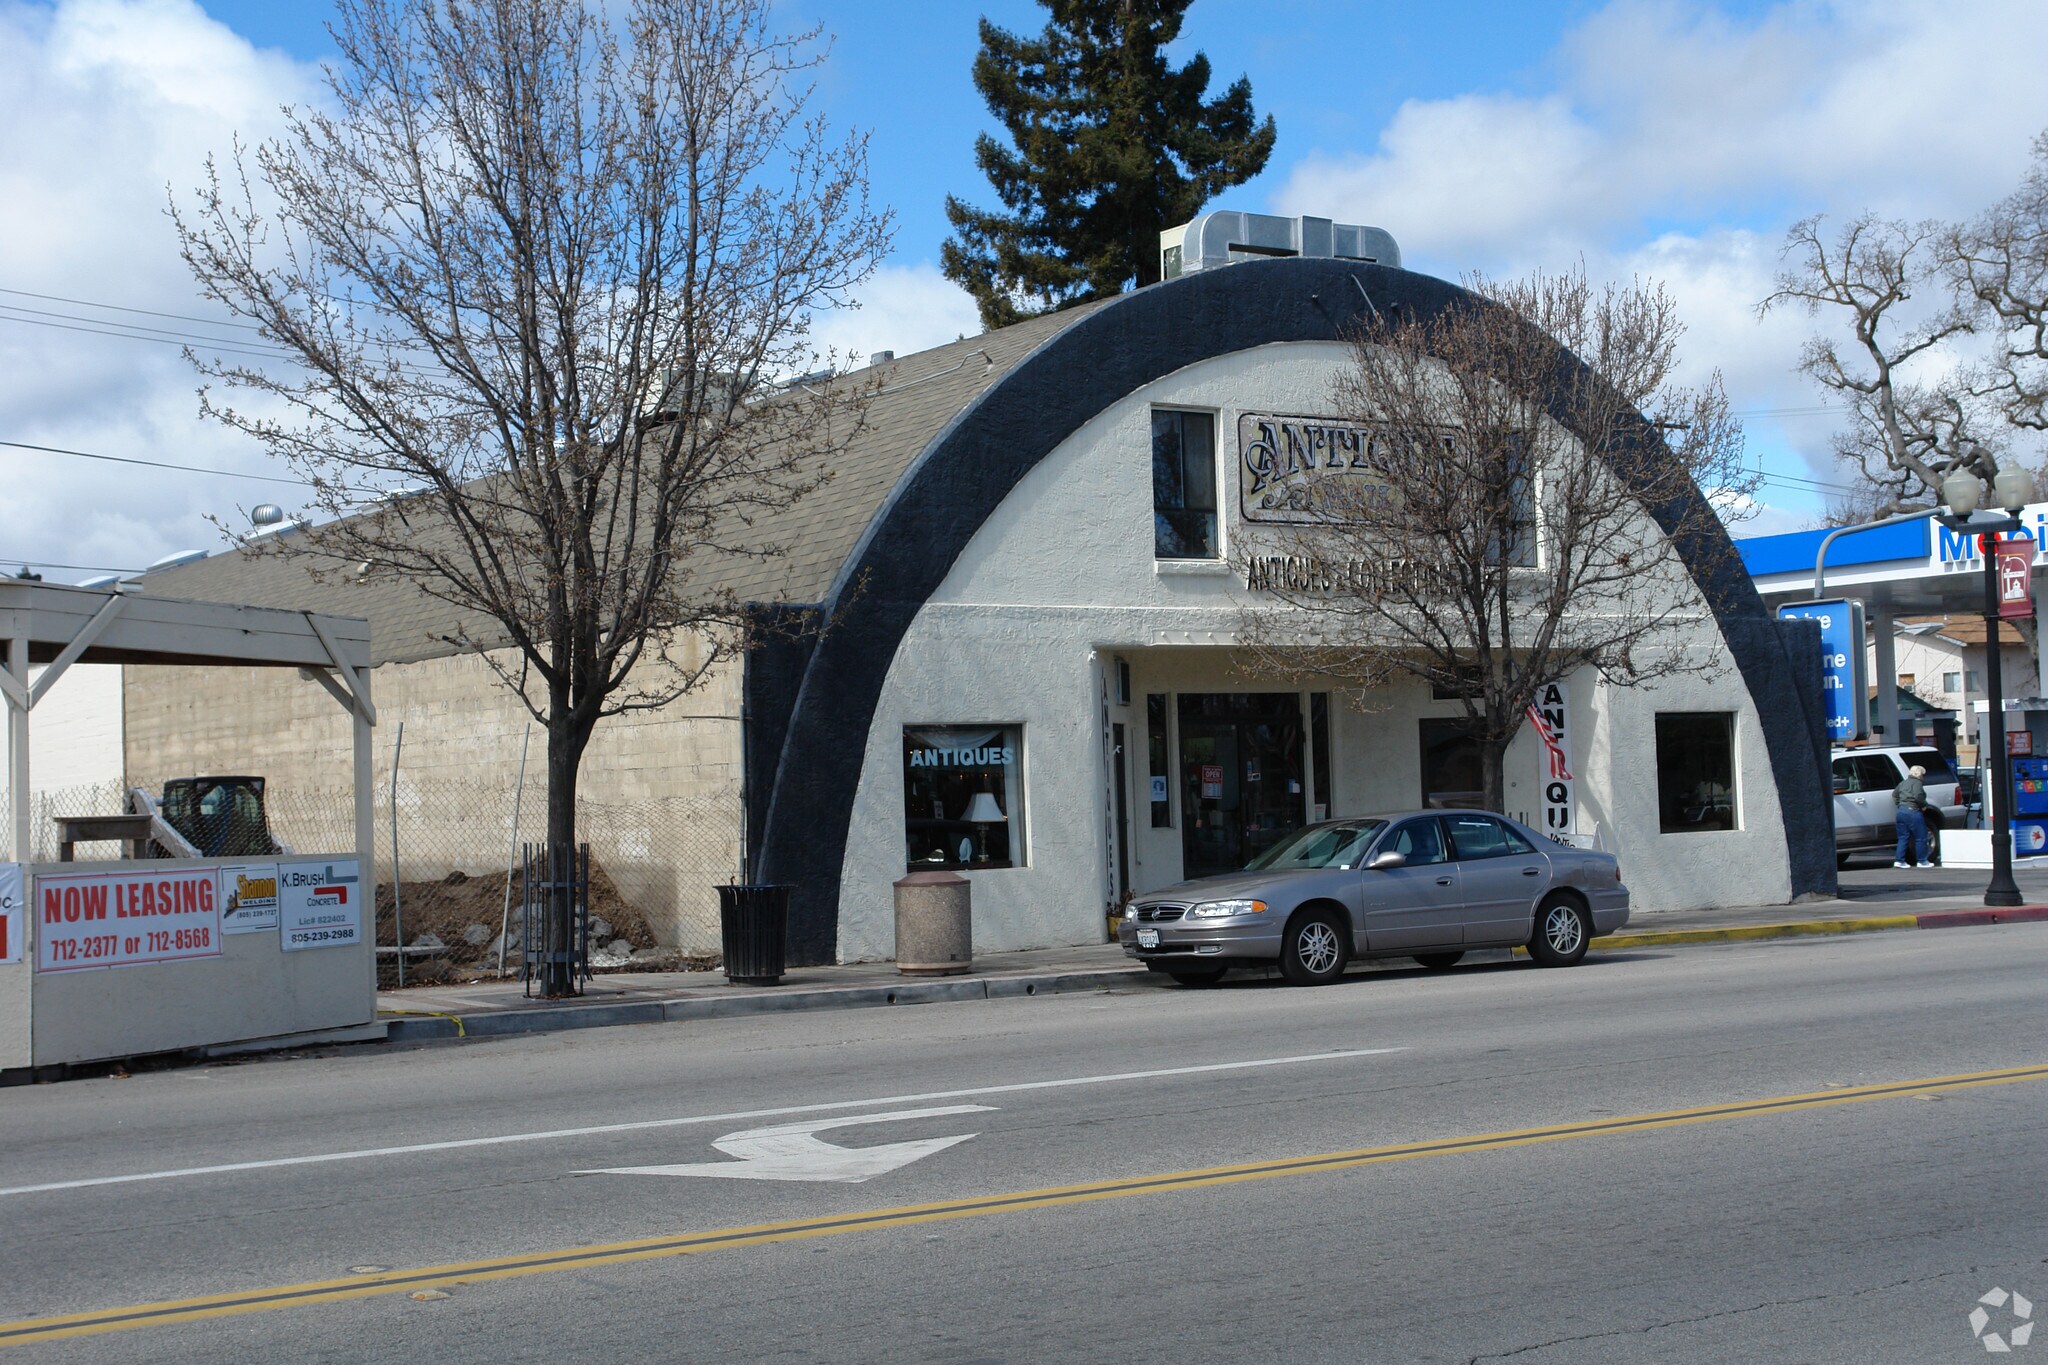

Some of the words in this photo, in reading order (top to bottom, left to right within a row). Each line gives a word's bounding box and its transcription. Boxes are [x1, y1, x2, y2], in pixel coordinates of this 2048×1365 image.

[910, 747, 1014, 767] ANTIQUES
[1205, 770, 1221, 778] OPEN
[236, 874, 276, 900] Shannon
[44, 884, 108, 924] NOW
[115, 878, 213, 919] LEASING
[307, 897, 338, 907] CONCRETE
[299, 917, 316, 926] Lic#
[50, 935, 118, 961] 712-2377
[124, 937, 140, 954] or
[146, 927, 210, 953] 712-8568
[291, 929, 354, 943] 805-239-2988
